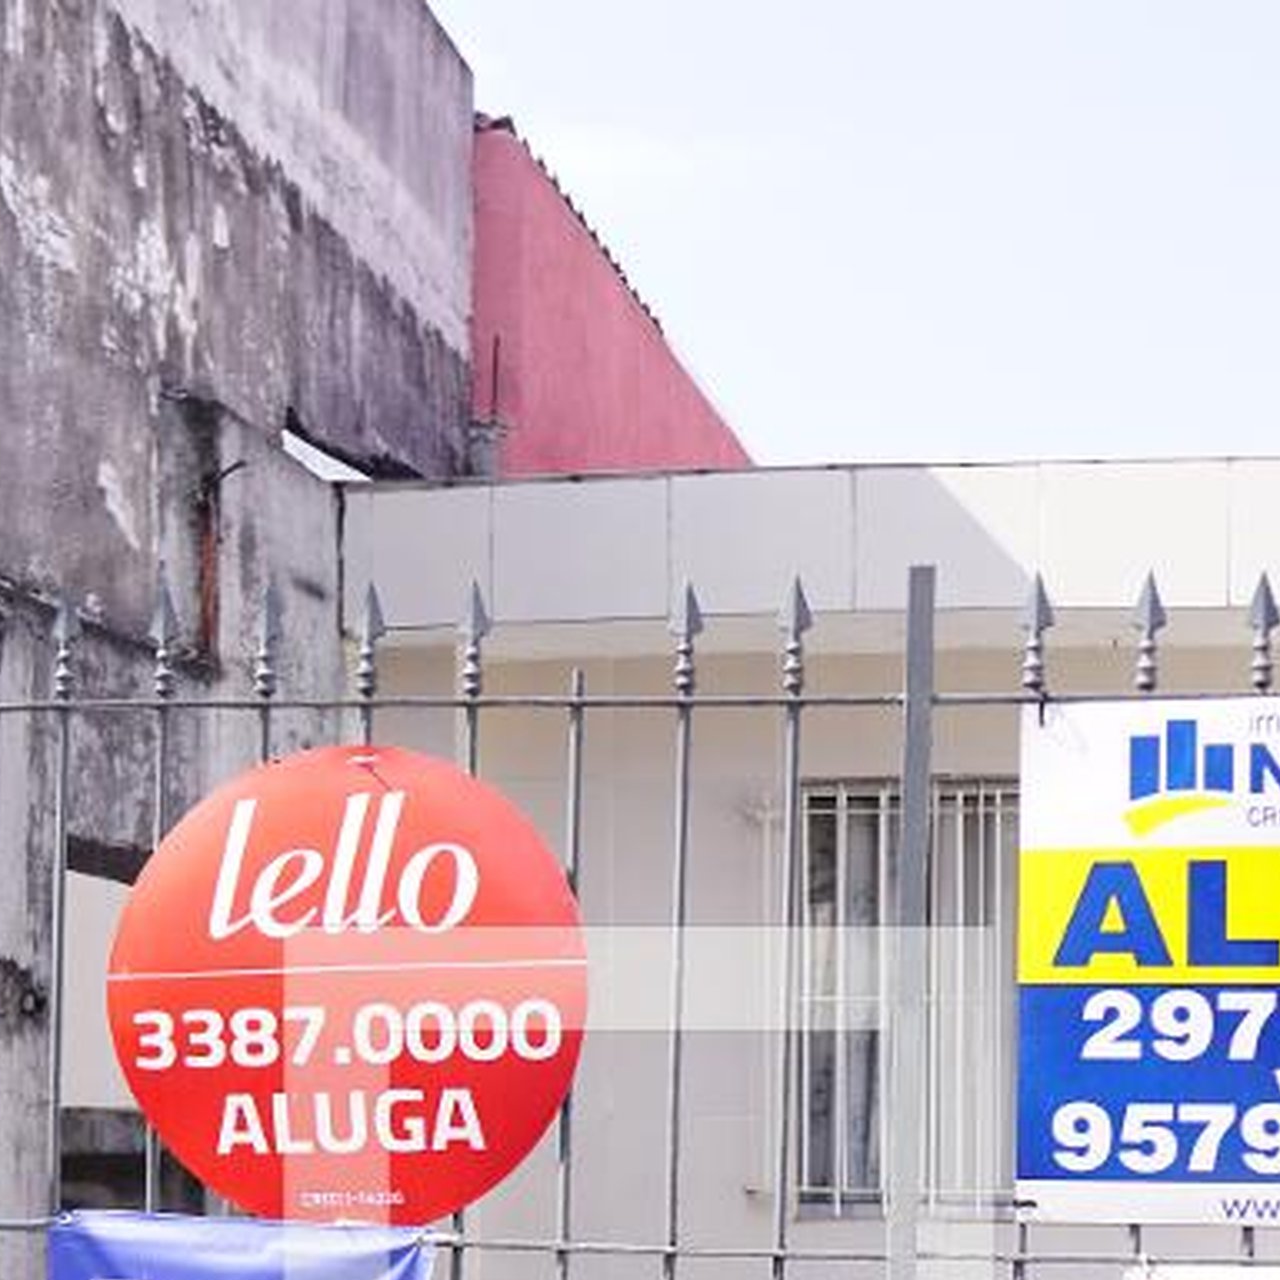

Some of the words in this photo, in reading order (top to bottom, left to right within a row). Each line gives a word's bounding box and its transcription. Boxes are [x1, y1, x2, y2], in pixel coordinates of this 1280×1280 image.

[208, 791, 479, 940] lello
[132, 1000, 562, 1070] 3387.0000
[217, 1088, 486, 1155] ALUGA
